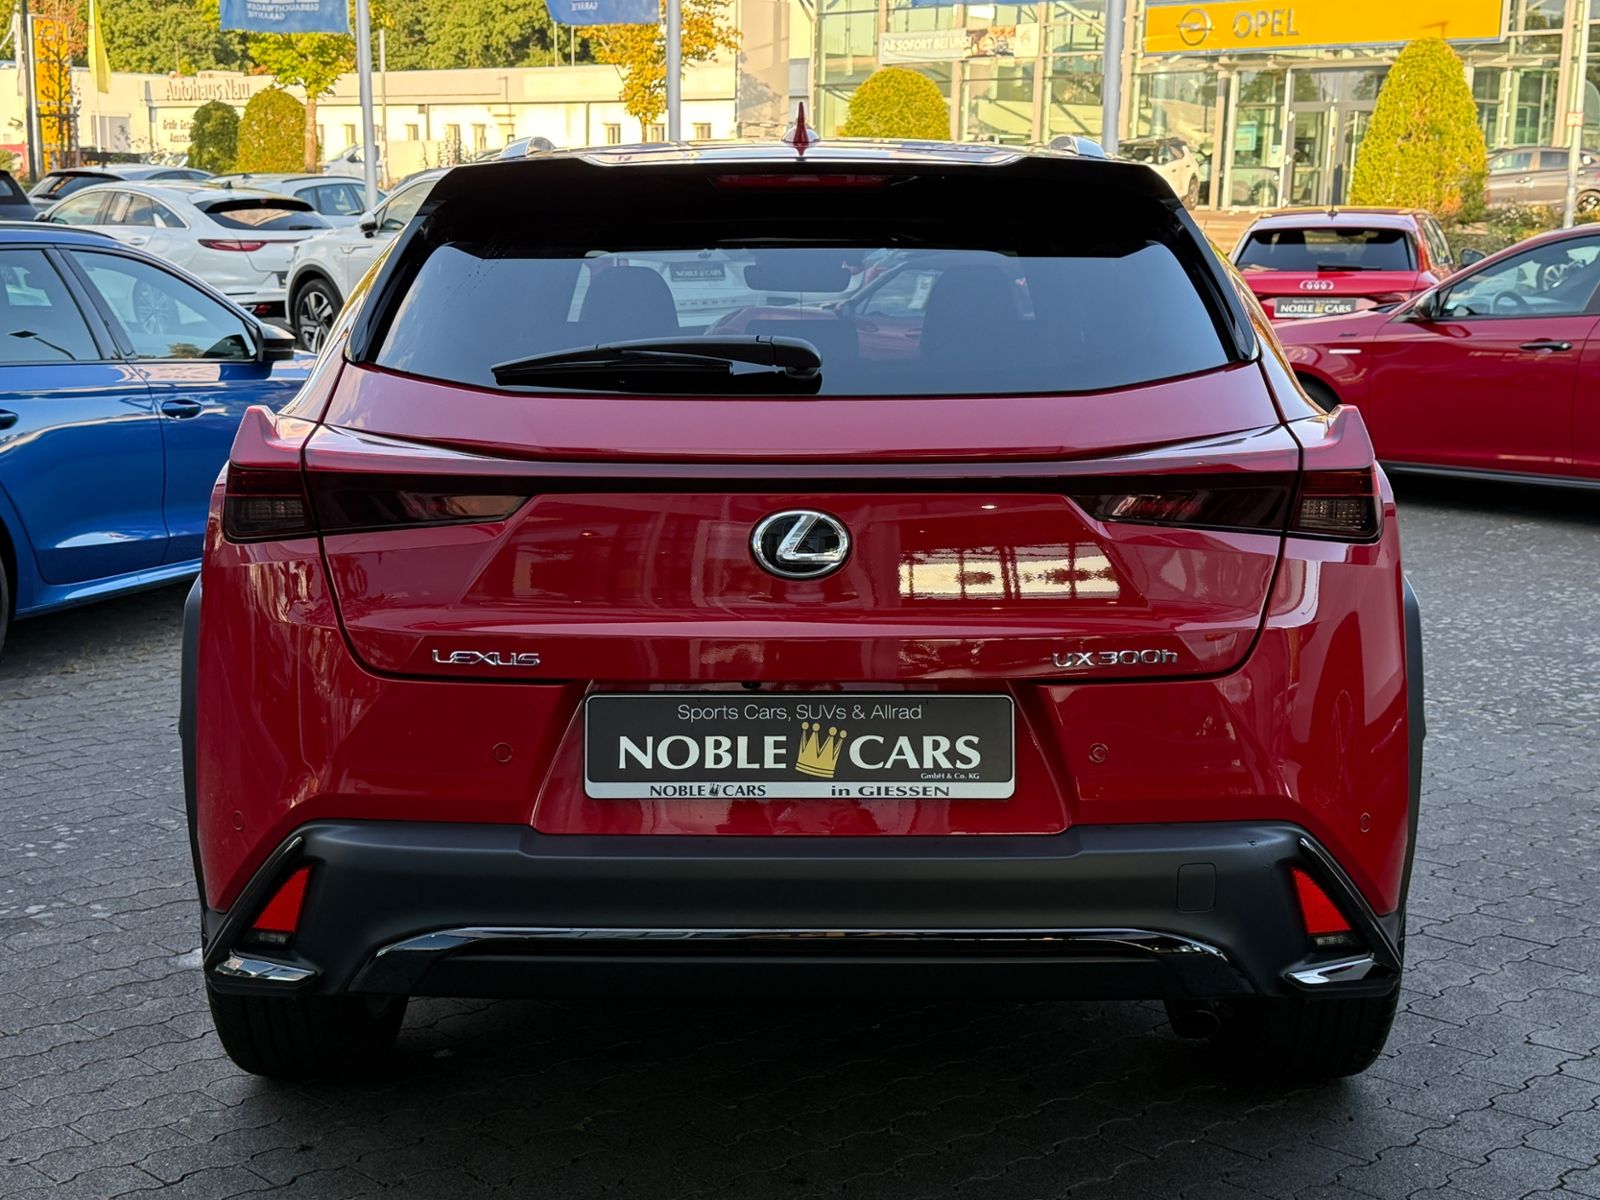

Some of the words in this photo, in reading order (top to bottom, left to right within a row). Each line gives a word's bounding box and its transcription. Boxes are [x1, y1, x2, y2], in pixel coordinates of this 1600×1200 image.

[1232, 8, 1300, 39] OPEL
[896, 38, 933, 51] SOFORT
[166, 80, 223, 101] Autohaus
[1280, 304, 1315, 313] NOBLE
[1324, 304, 1352, 313] CARS
[432, 649, 541, 666] LEXUS
[1053, 651, 1096, 667] UX
[1098, 649, 1178, 665] 300h
[677, 703, 739, 723] Sports
[743, 703, 791, 722] Cars,
[796, 703, 847, 720] SUVs
[851, 703, 866, 720] &
[870, 703, 922, 720] Allrad
[618, 735, 787, 770] NOBLE
[849, 734, 981, 770] CARS
[920, 772, 945, 780] GmbH
[968, 772, 980, 780] KG
[650, 785, 706, 797] NOBLE
[722, 784, 751, 797] CARS
[831, 785, 850, 797] in
[857, 785, 950, 797] GIESSEN
